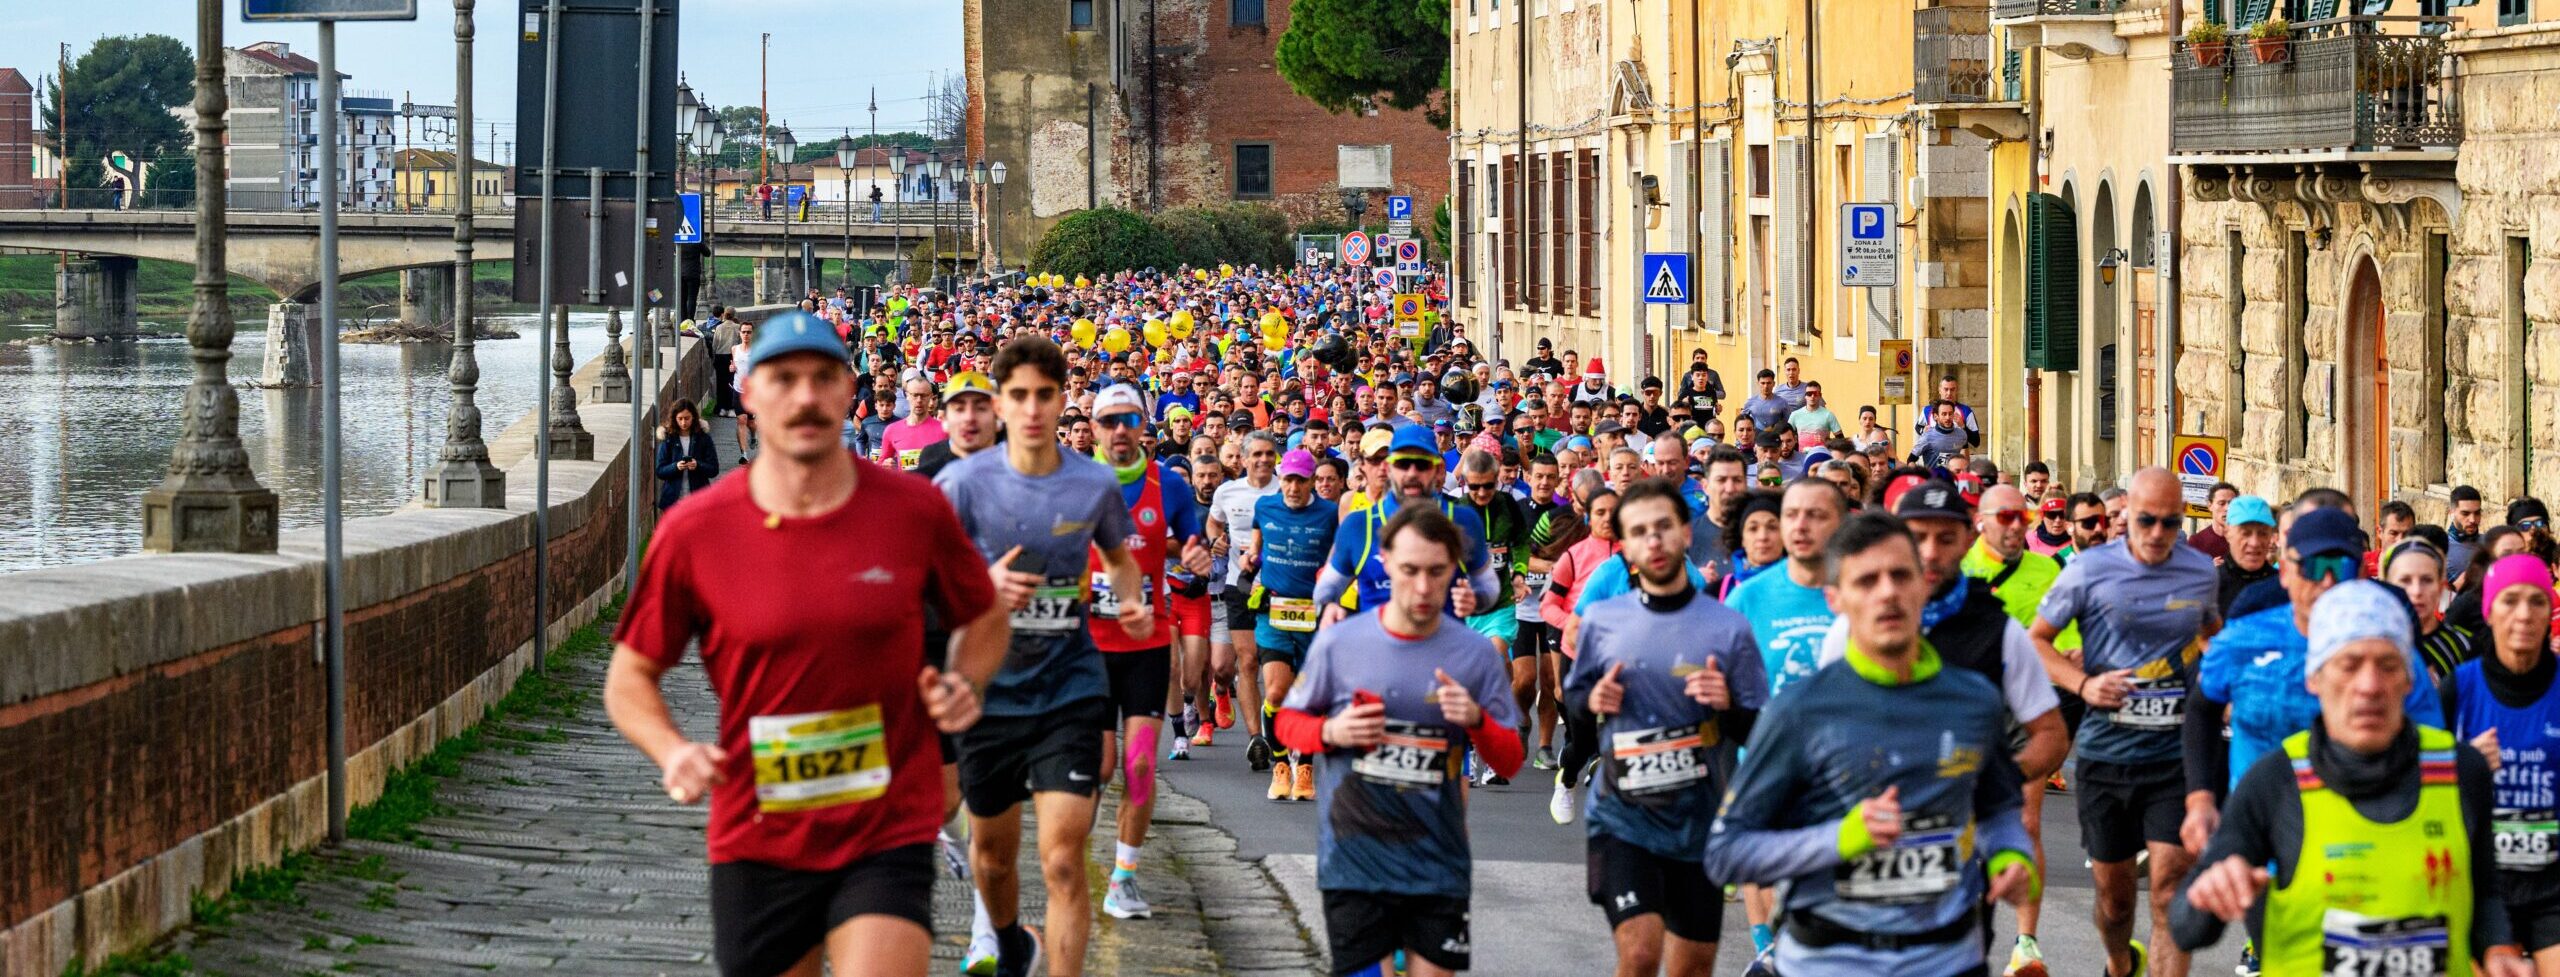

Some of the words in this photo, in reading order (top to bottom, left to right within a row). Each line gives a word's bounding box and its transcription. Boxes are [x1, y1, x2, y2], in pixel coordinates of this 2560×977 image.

[1393, 199, 1407, 217] P
[1860, 211, 1878, 235] P
[1280, 610, 1306, 621] 304
[2121, 697, 2178, 716] 2487
[772, 744, 869, 783] 1627
[1363, 746, 1437, 771] 2267
[1625, 747, 1695, 777] 2266
[2493, 764, 2555, 786] eltic
[1851, 844, 1946, 881] 2702
[2334, 946, 2434, 977] 2798
